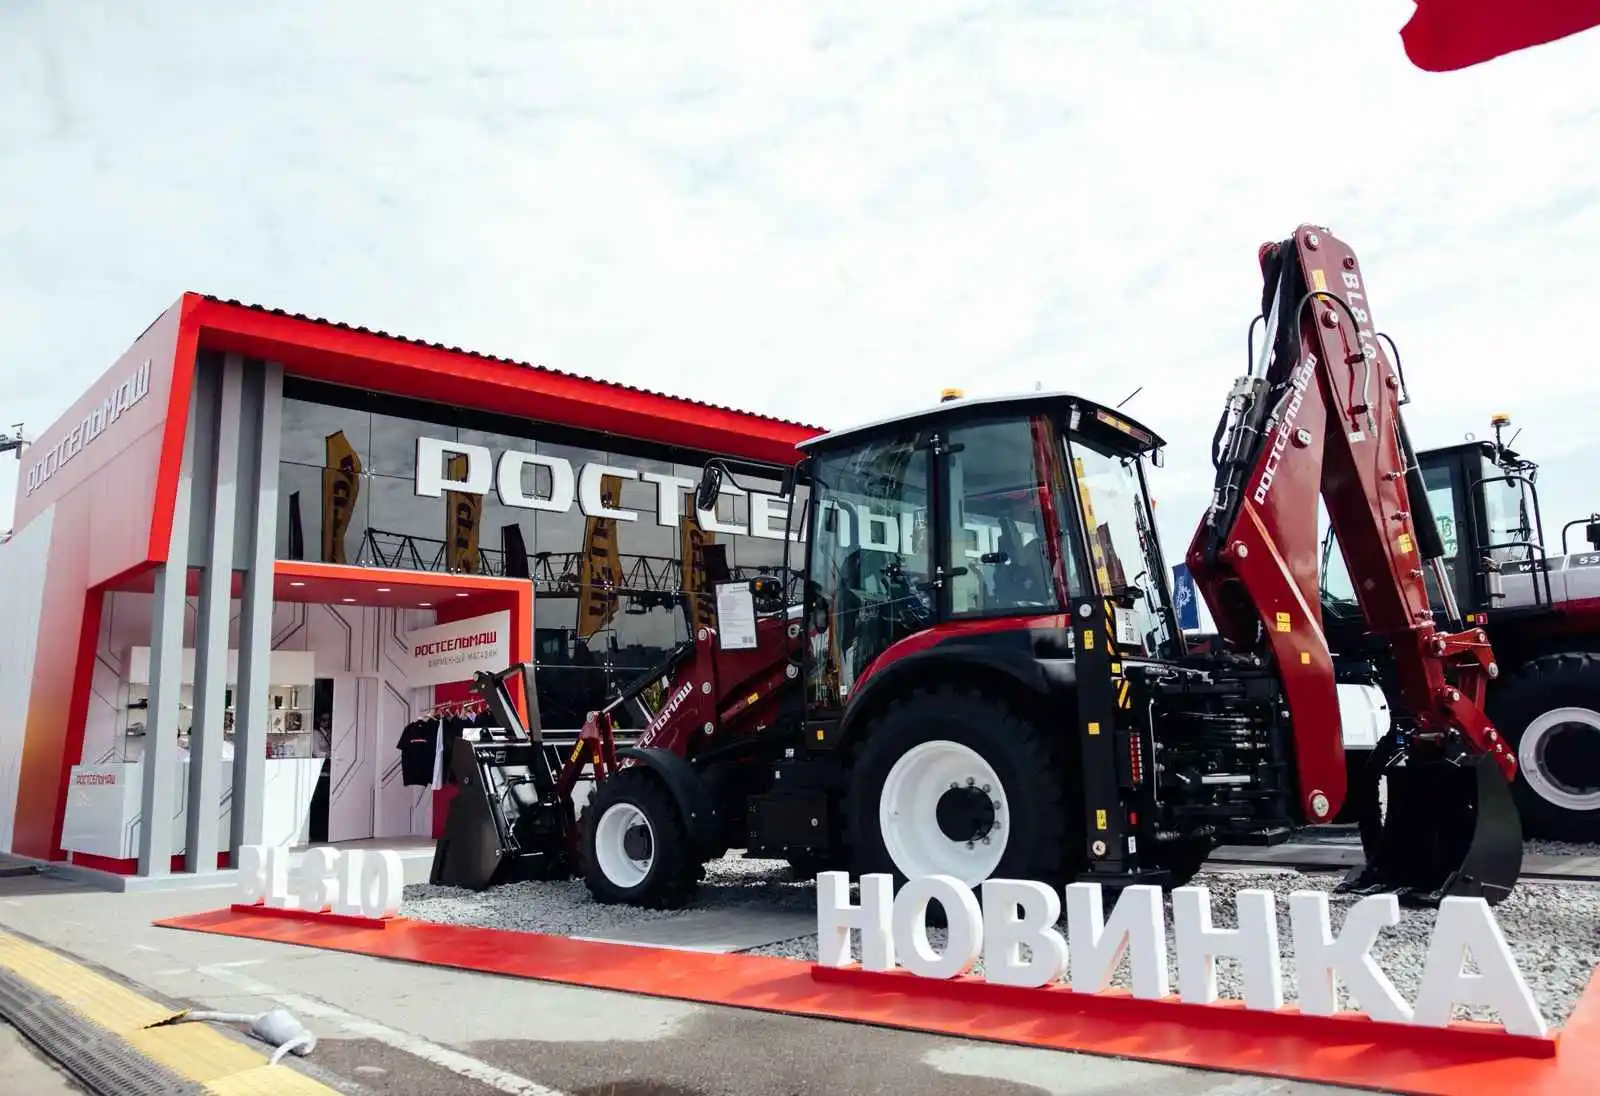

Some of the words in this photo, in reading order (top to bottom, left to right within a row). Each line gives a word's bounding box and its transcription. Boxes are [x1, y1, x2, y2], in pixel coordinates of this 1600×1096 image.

[1341, 271, 1377, 360] BL810
[25, 358, 152, 498] РОСТСЕЛЬМАШ
[1253, 351, 1318, 506] РОСТСЕЛЬМАШ
[415, 437, 1038, 558] РОСТСЕЛЬА
[414, 631, 497, 657] РОСТСЕЛЬМАШ
[238, 845, 404, 919] BL810
[816, 870, 1549, 1038] НОВИНКА
